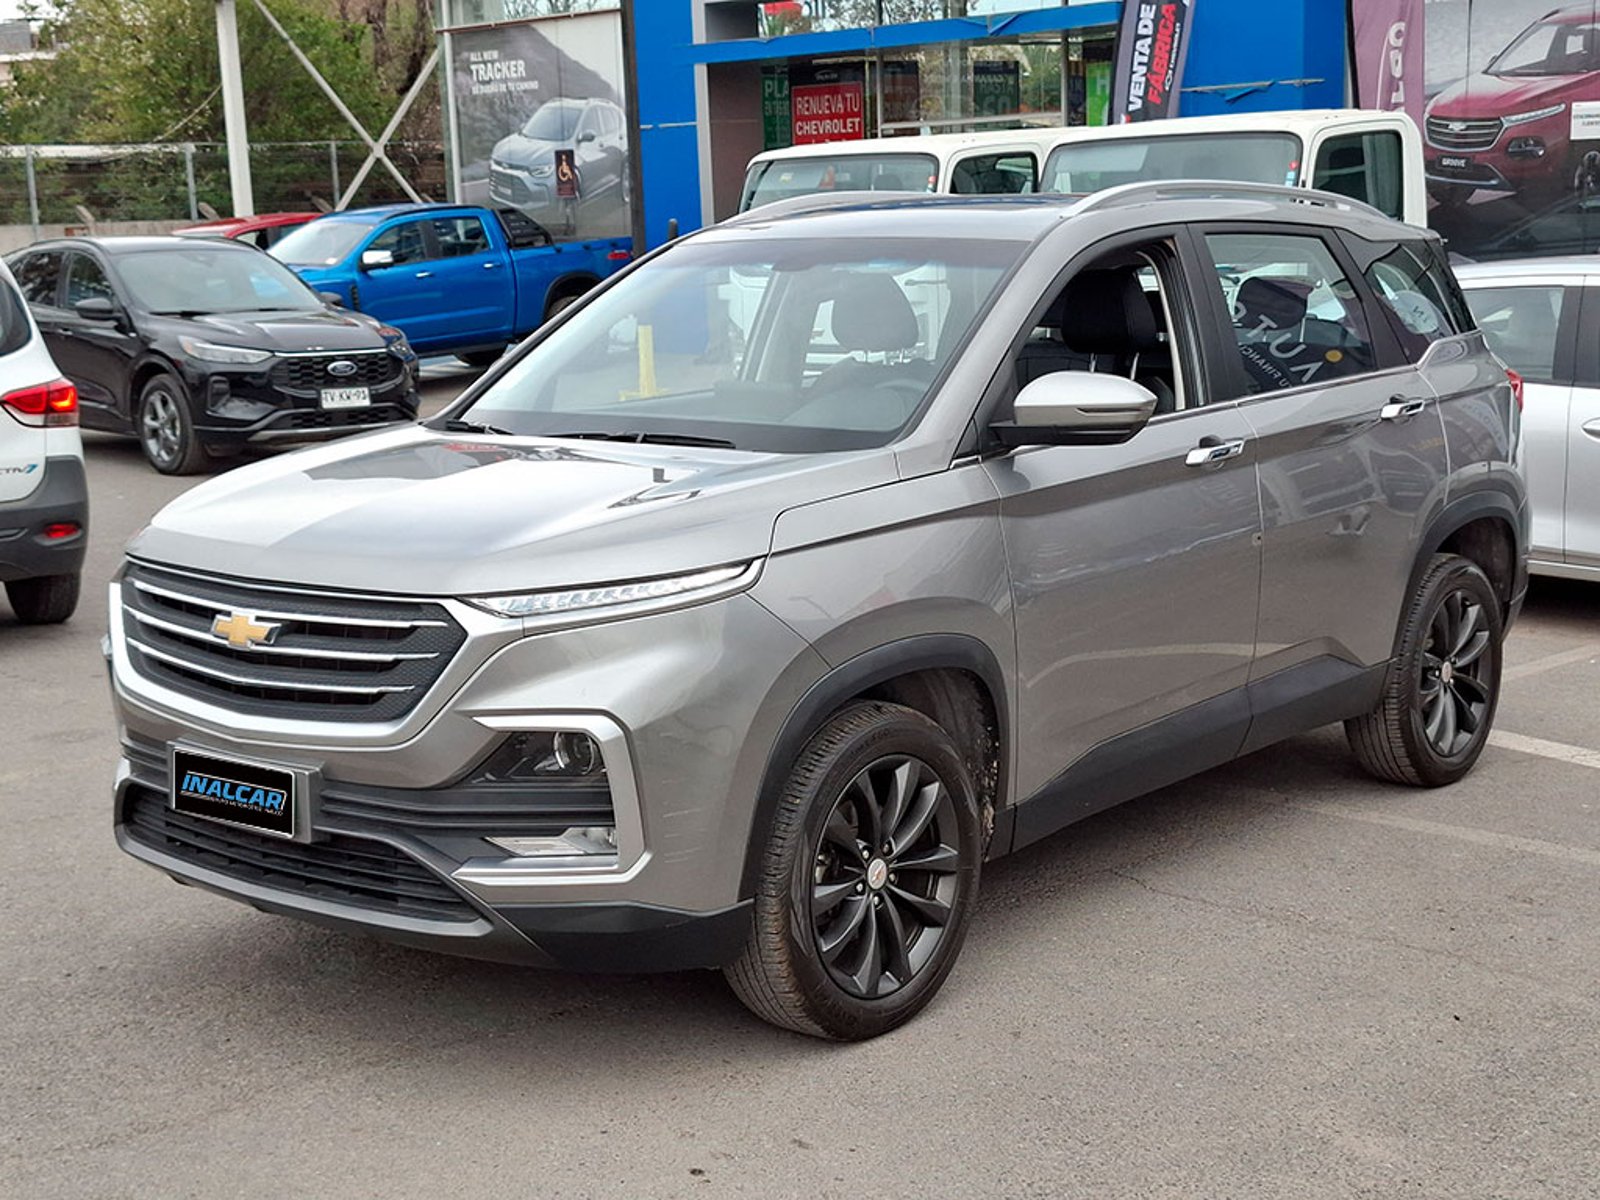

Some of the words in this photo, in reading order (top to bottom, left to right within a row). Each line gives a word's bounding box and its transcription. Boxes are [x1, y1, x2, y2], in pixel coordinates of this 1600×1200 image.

[1138, 3, 1157, 36] DE
[1147, 4, 1177, 104] FÁBRICA
[470, 60, 526, 81] TRACKER
[1128, 36, 1152, 112] VENTA
[796, 94, 844, 116] RENUEVA
[845, 92, 860, 113] TU
[795, 117, 860, 136] CHEVROLET
